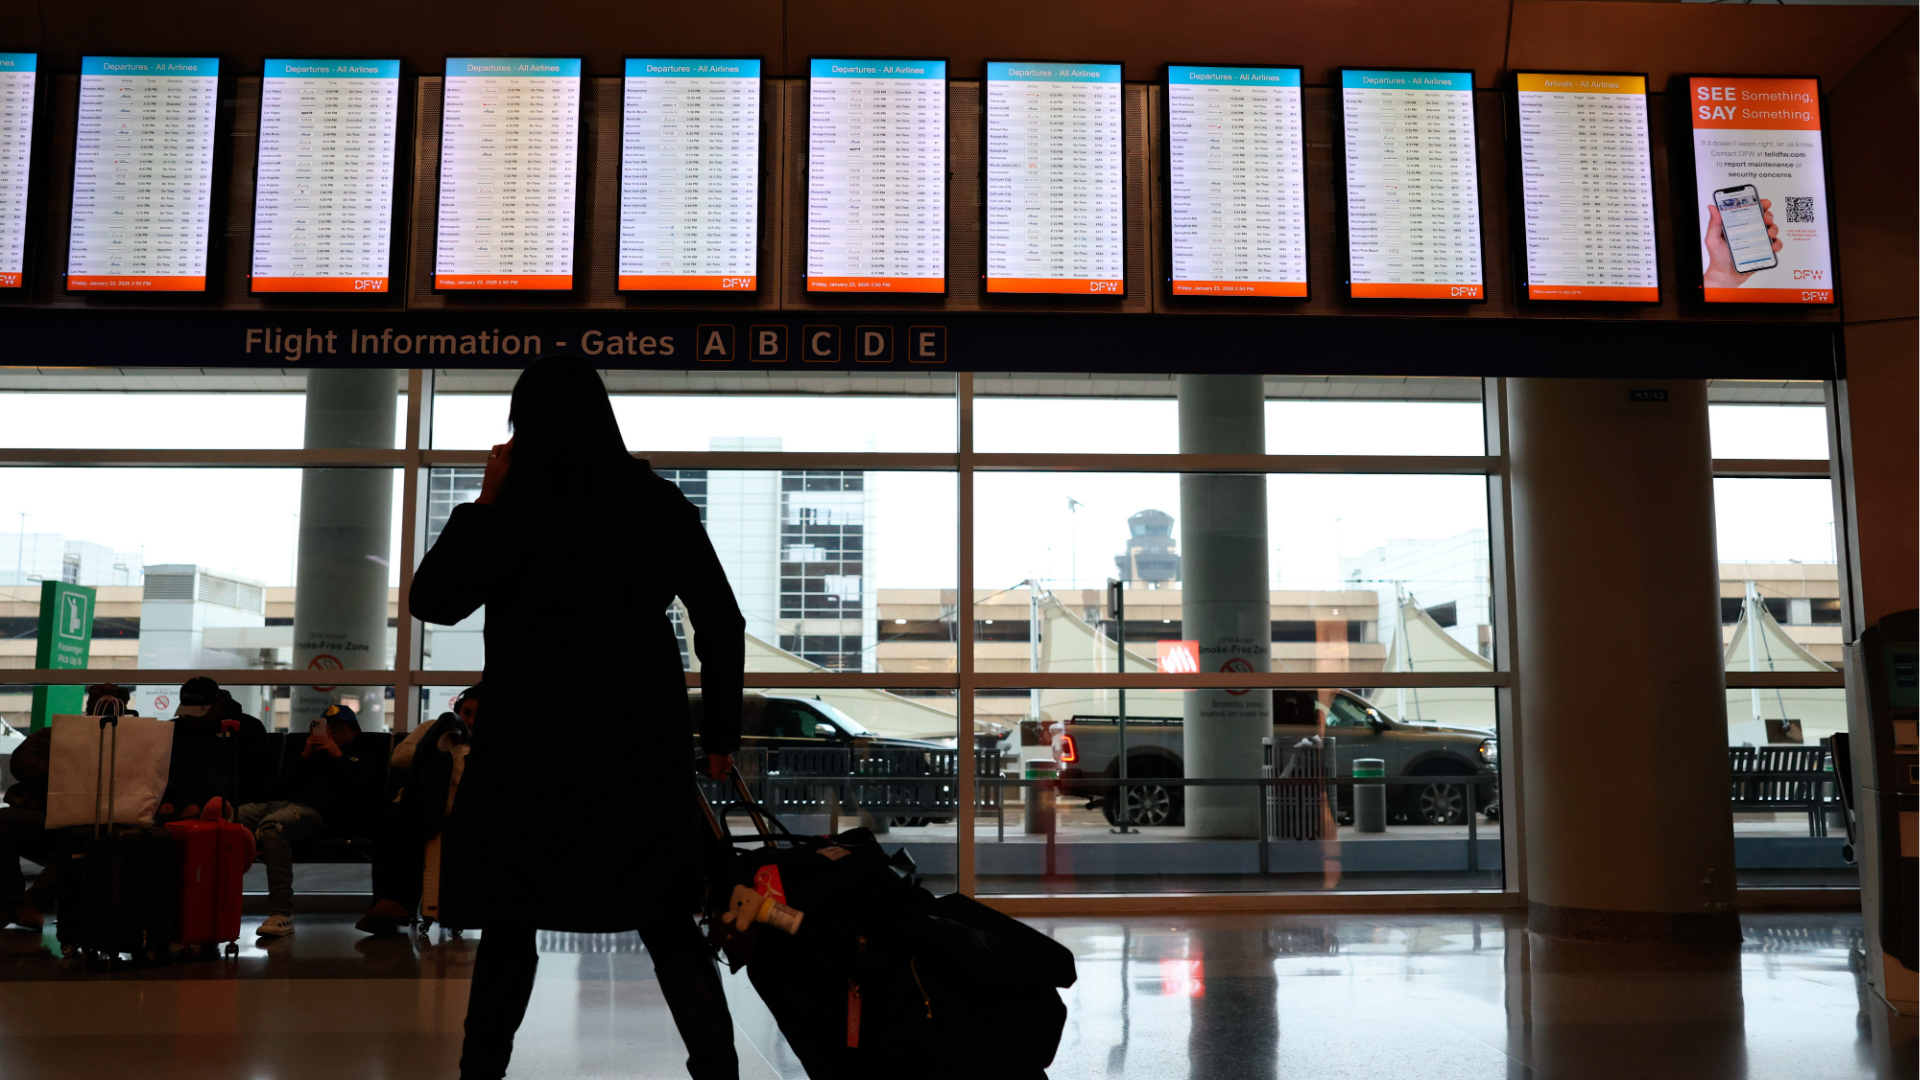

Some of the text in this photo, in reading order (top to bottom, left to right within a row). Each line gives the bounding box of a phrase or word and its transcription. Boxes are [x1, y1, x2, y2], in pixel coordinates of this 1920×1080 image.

[832, 66, 875, 74] Departures
[1009, 69, 1052, 77] Departures
[1698, 87, 1813, 103] SEE Something,
[1699, 106, 1813, 121] SAY Something.
[1794, 270, 1823, 280] DFW
[355, 280, 382, 290] DFW
[723, 279, 750, 288] DFW
[1090, 282, 1117, 291] DFW
[1451, 287, 1477, 296] DFW
[1802, 292, 1828, 301] DFW
[245, 328, 337, 361] Flight
[351, 328, 541, 355] Information
[581, 330, 675, 356] Gates
[704, 331, 726, 355] A
[759, 331, 778, 355] B
[812, 331, 831, 356] C
[864, 332, 884, 356] D
[919, 332, 936, 356] E
[346, 642, 369, 651] Zone
[58, 654, 68, 663] Pick
[70, 657, 77, 666] Up
[300, 696, 328, 705] Smoking
[1212, 700, 1244, 708] Smoking
